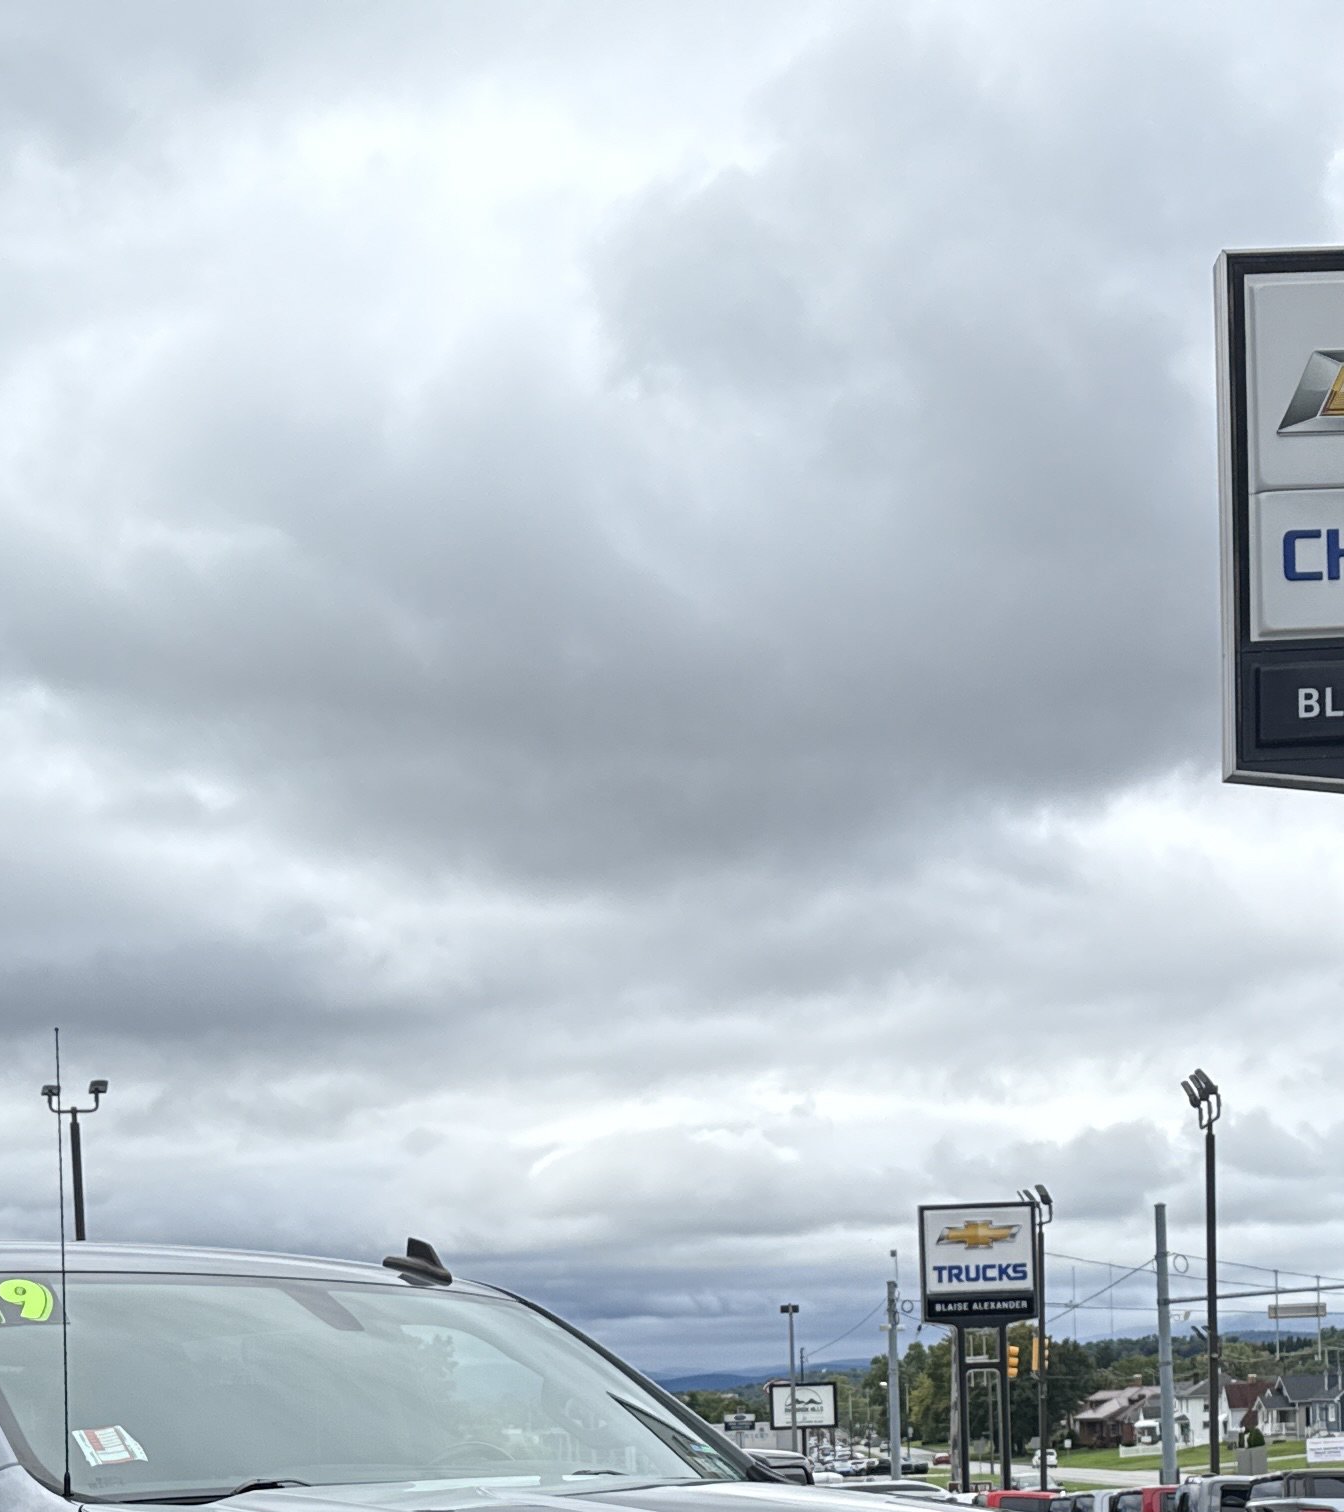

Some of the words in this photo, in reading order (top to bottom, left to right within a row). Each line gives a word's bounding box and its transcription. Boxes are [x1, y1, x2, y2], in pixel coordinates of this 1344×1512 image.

[932, 1263, 1028, 1283] TRUCKS
[935, 1302, 969, 1312] BLAISE
[972, 1300, 1028, 1311] ALEXANDER
